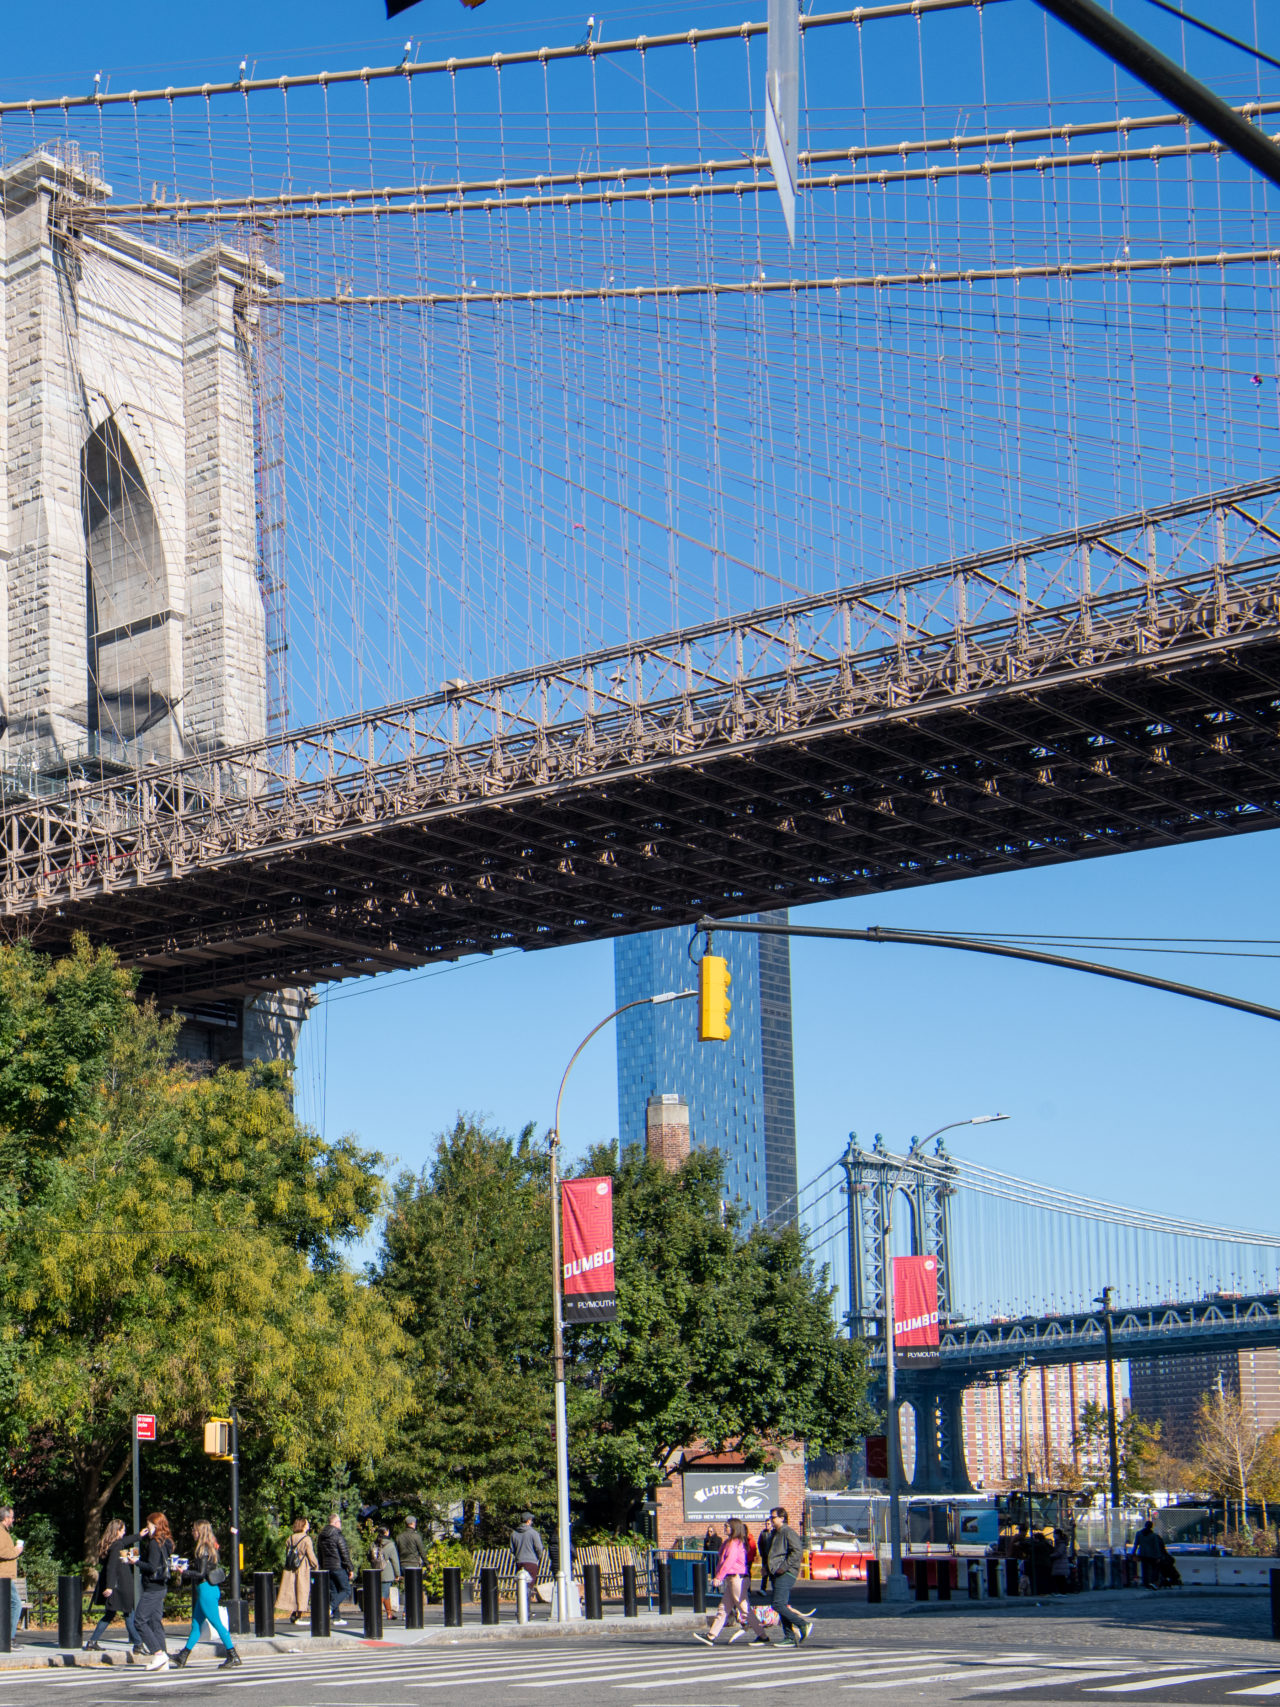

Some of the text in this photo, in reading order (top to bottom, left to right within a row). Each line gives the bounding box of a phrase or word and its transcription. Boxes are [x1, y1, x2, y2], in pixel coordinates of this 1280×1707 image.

[564, 1248, 615, 1279] DUMBO
[577, 1300, 615, 1309] PLYMOUTH
[895, 1311, 939, 1335] DUMBO
[705, 1484, 743, 1497] LUKE'S
